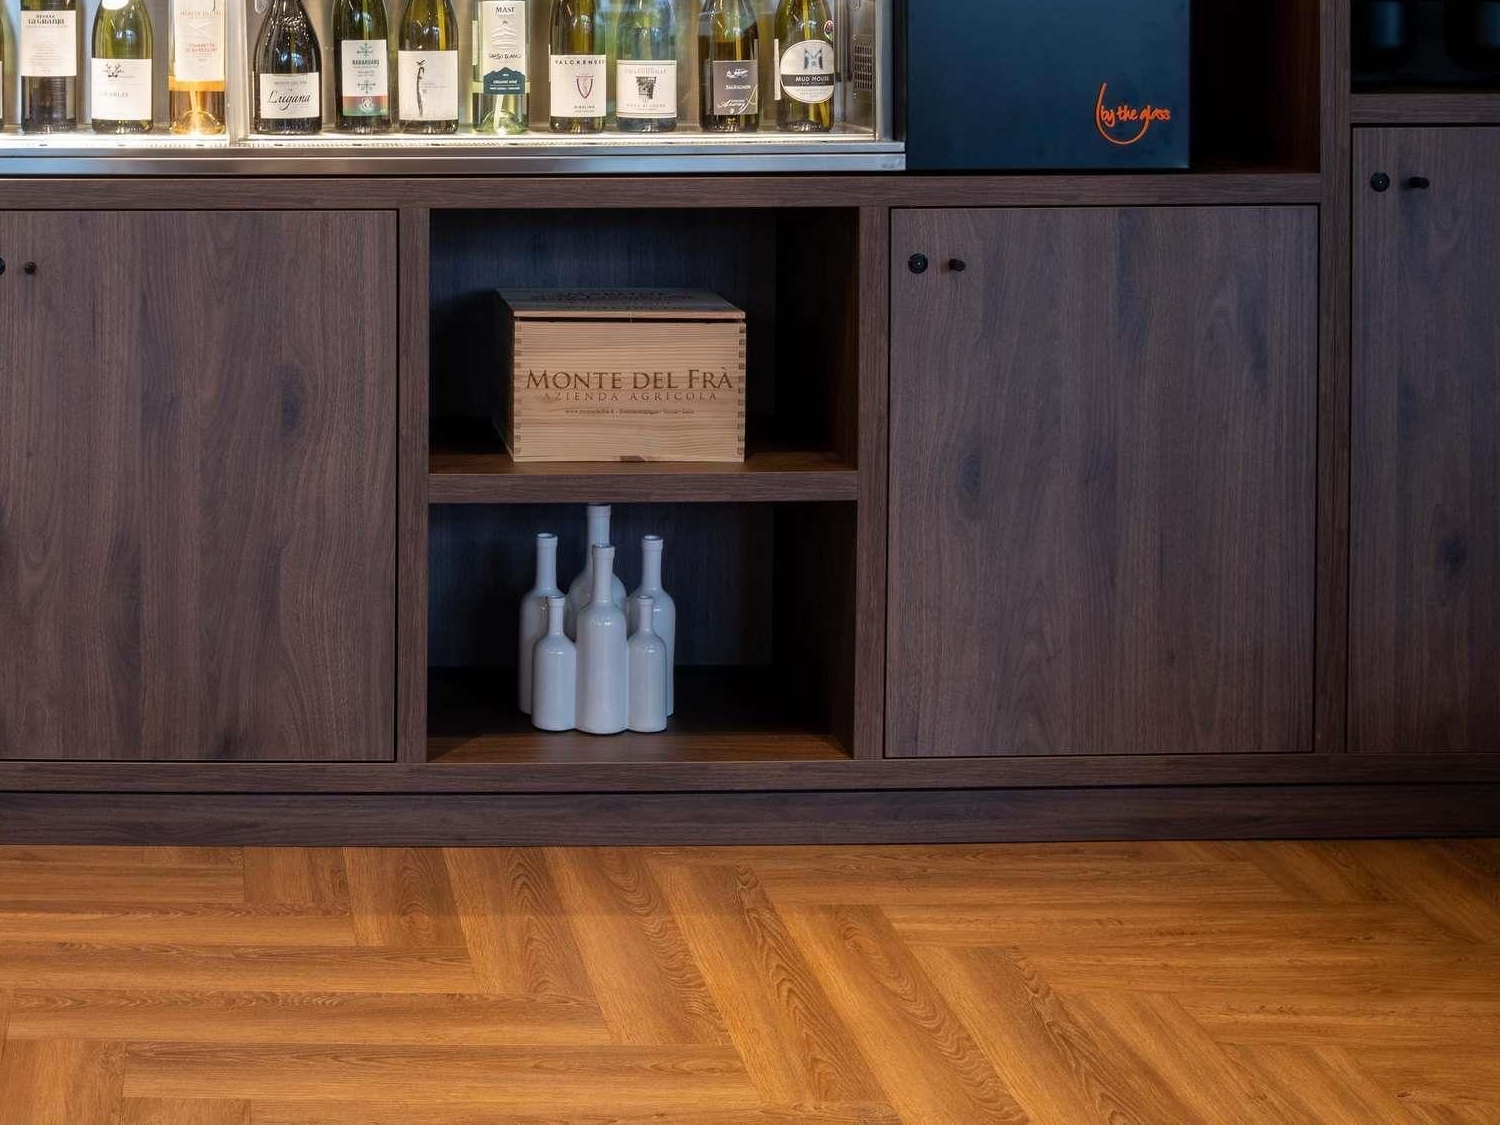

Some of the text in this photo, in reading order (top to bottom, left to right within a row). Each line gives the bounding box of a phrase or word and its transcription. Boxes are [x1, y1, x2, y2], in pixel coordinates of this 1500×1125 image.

[1116, 104, 1138, 122] the
[525, 367, 734, 390] MONTE DEL FRÀ
[544, 391, 718, 402] AZIENDA AGRICOLA
